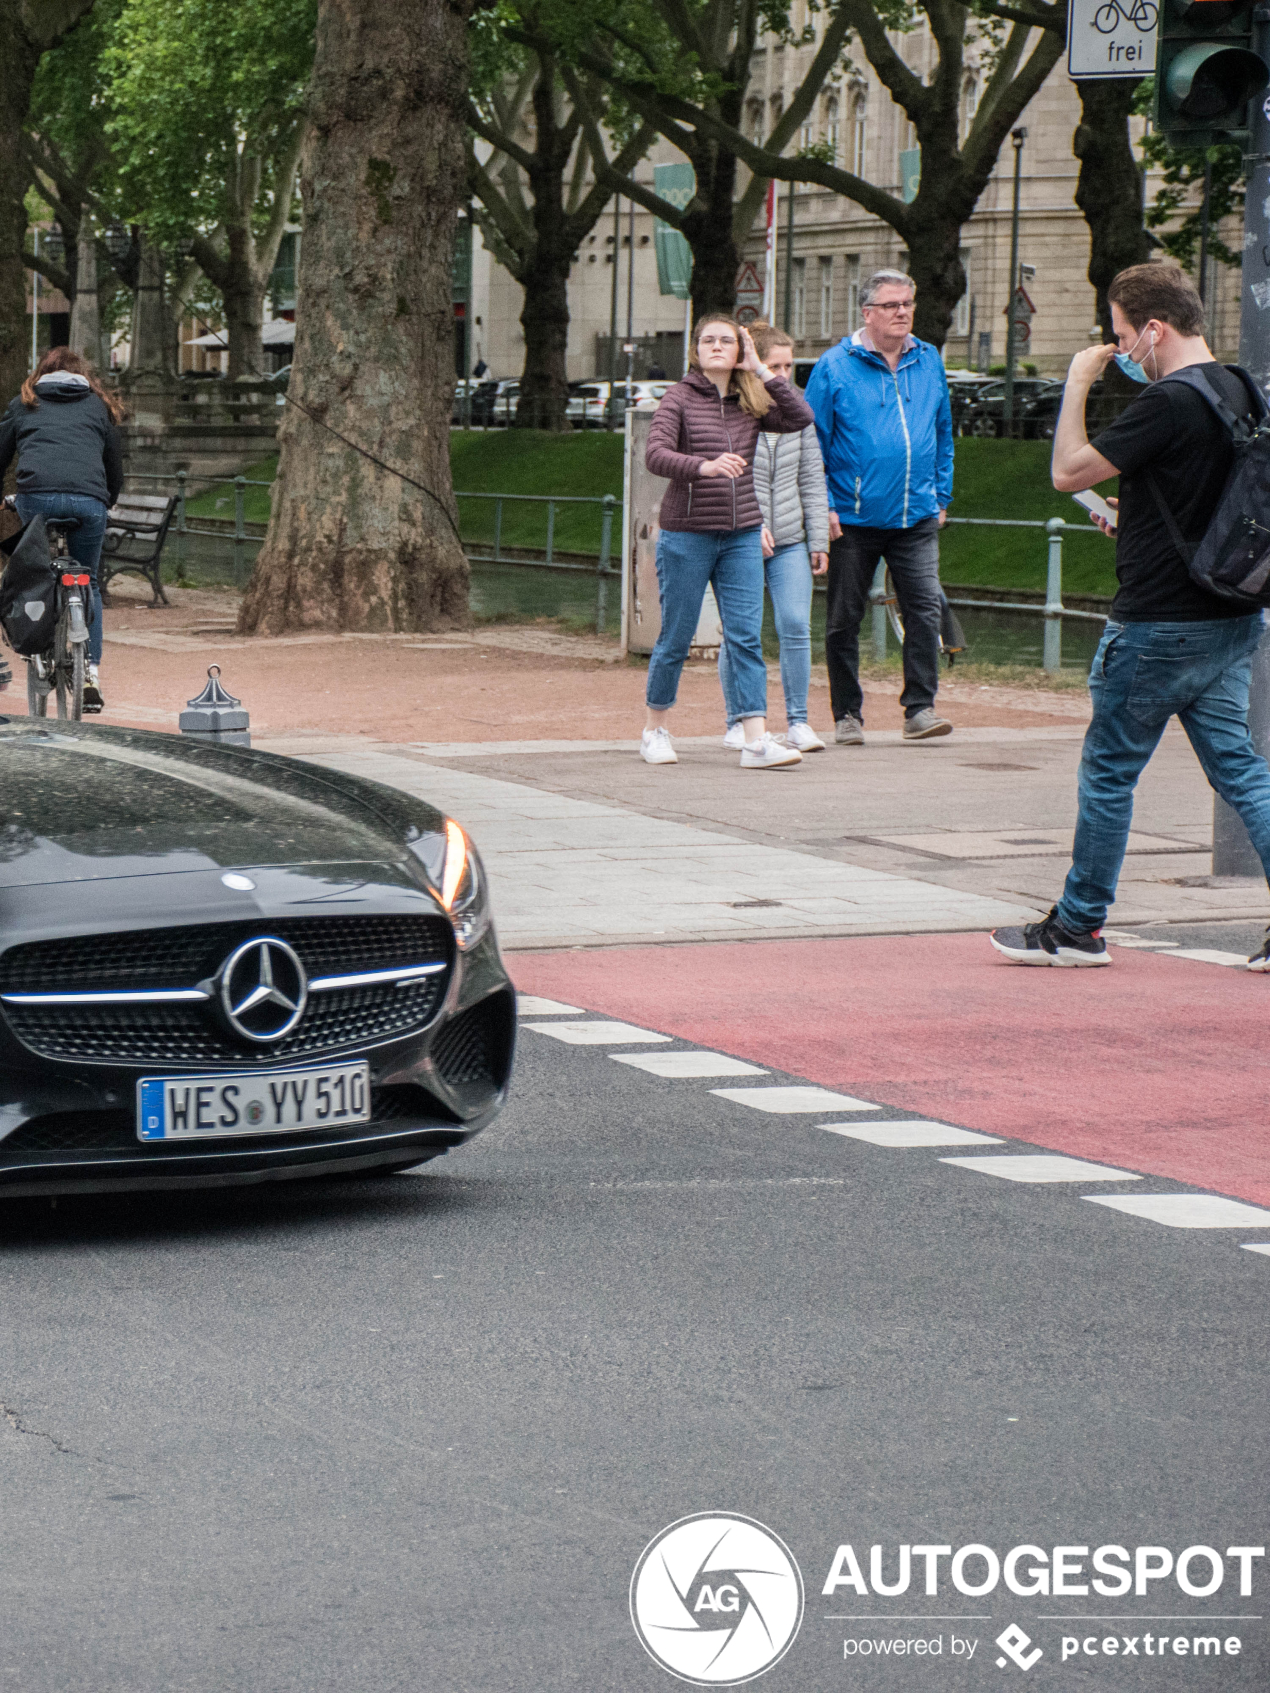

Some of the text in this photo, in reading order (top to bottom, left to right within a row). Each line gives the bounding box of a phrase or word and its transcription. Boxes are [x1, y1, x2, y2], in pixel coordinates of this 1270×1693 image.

[1107, 39, 1143, 62] frei
[168, 1071, 365, 1131] WES YY 510
